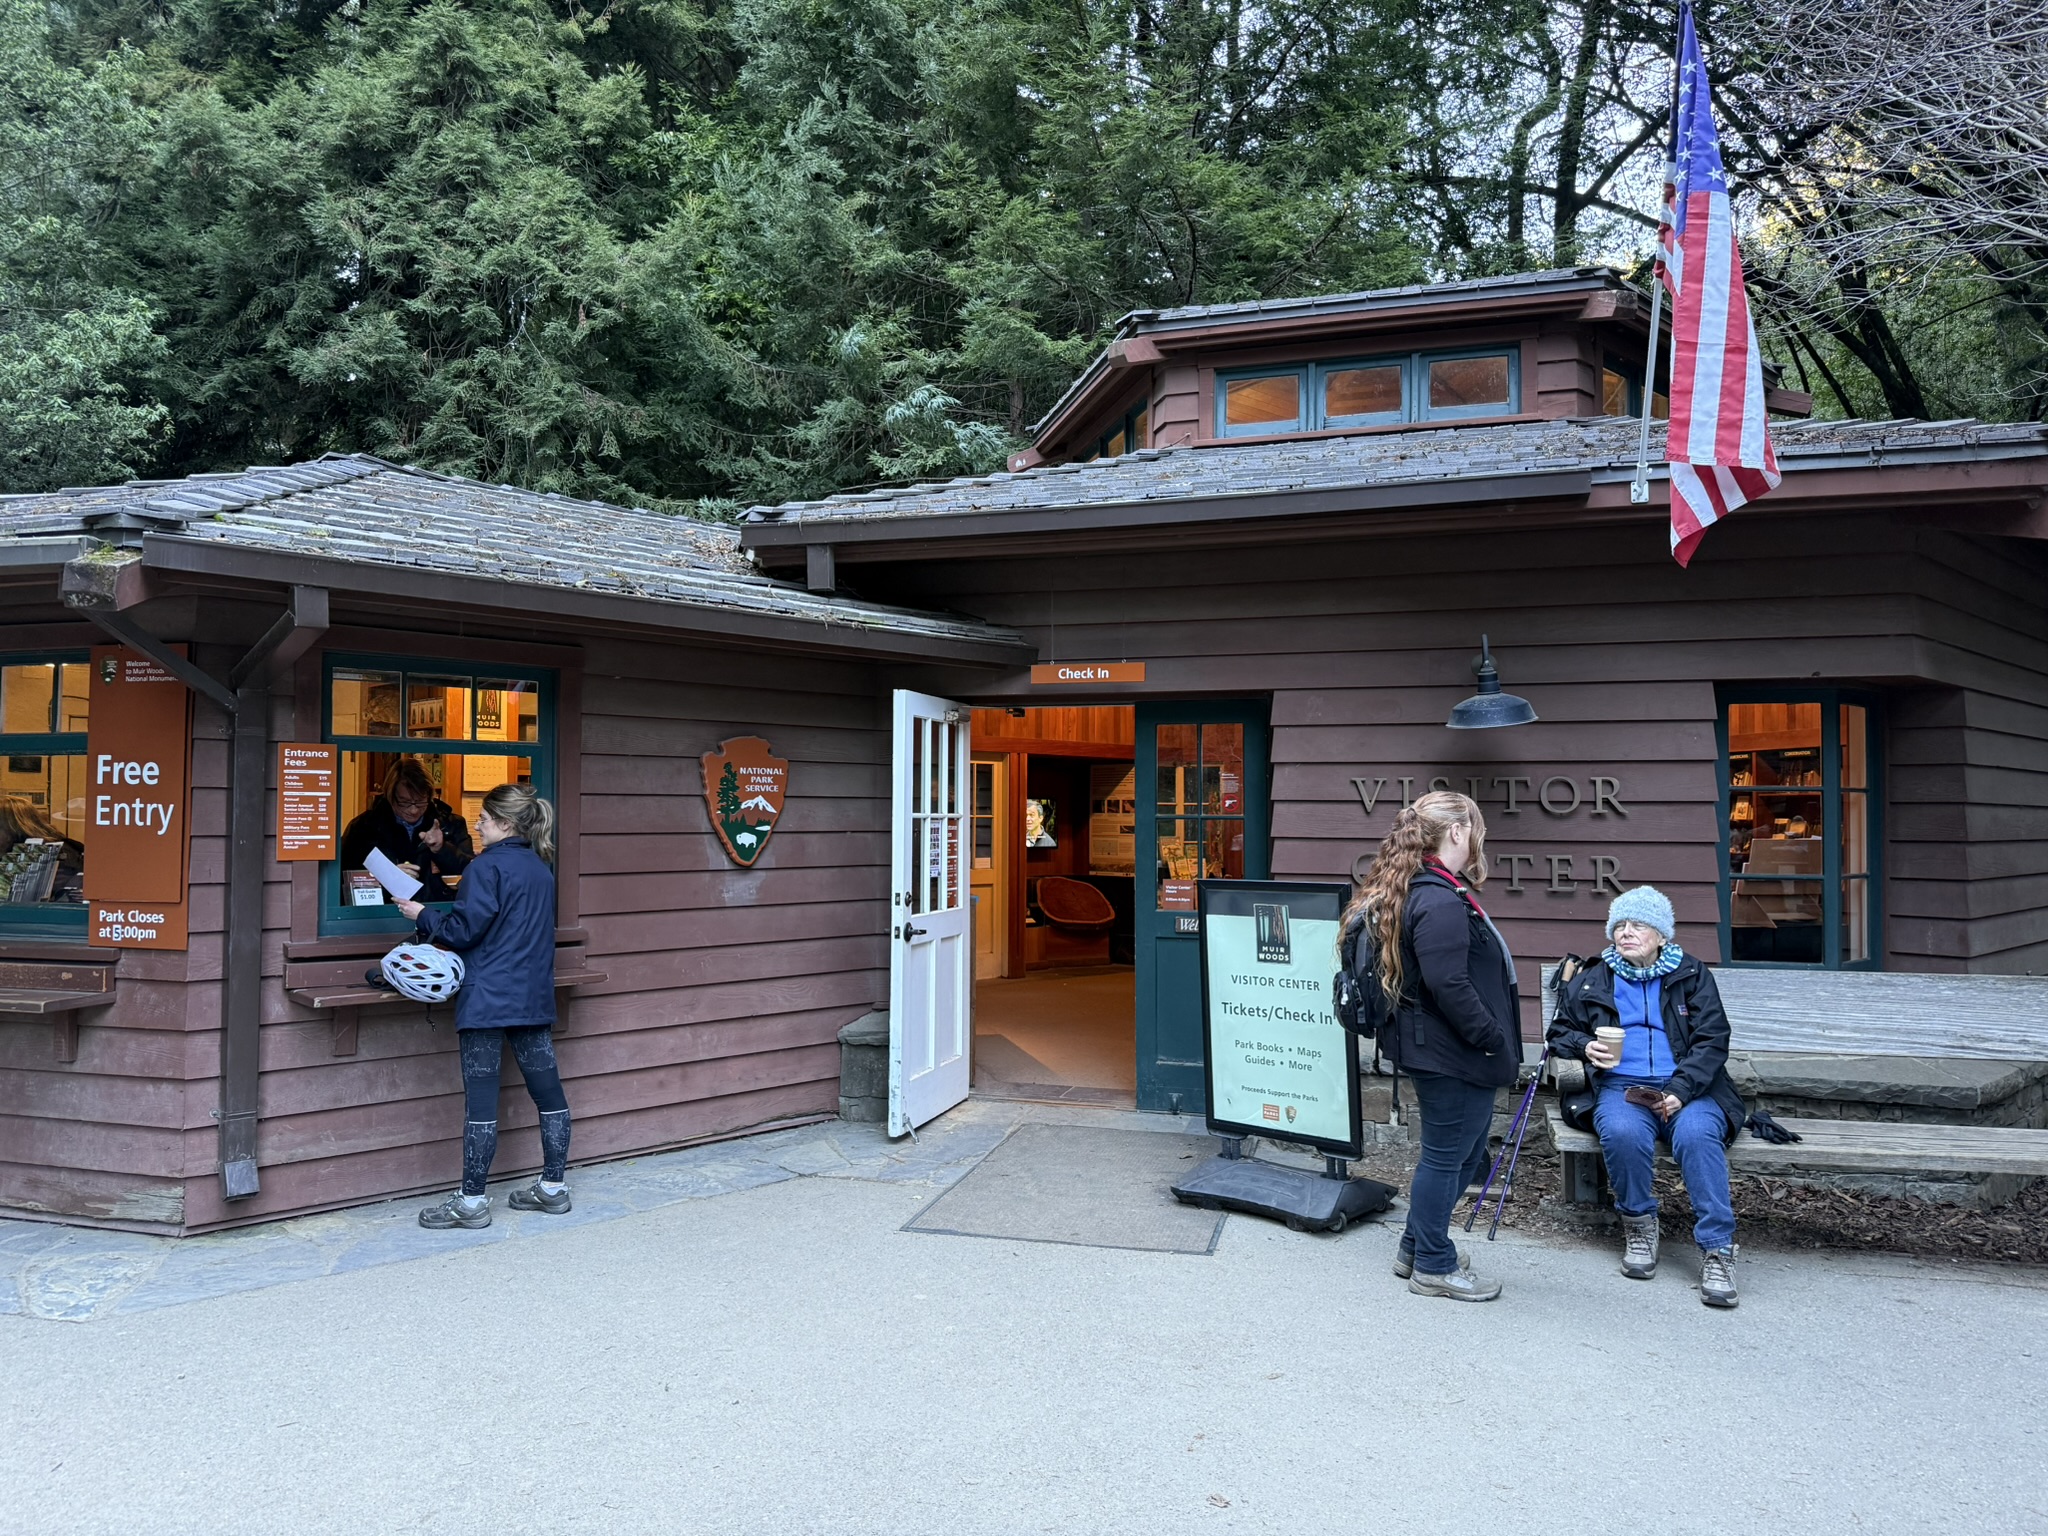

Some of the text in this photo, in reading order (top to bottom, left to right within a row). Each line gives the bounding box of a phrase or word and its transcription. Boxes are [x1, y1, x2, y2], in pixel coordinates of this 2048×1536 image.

[1058, 667, 1109, 679] Check In
[284, 748, 329, 758] Entrance
[97, 754, 160, 785] Free
[284, 758, 307, 766] Fees
[740, 767, 784, 775] NATIONAL
[750, 776, 774, 784] PARK
[96, 796, 175, 836] Entry
[99, 909, 165, 924] Park Closes
[99, 926, 157, 941] at 5:00pm
[1259, 953, 1289, 961] WOODS
[1231, 974, 1320, 991] VISITOR CENTER
[1222, 1002, 1333, 1025] Tickets/Check In
[1235, 1040, 1322, 1060] Park Books Maps
[1244, 1055, 1313, 1072] Guides More
[1241, 1085, 1267, 1094] Proceeds
[1267, 1088, 1290, 1097] Support
[1302, 1094, 1319, 1102] Parks
